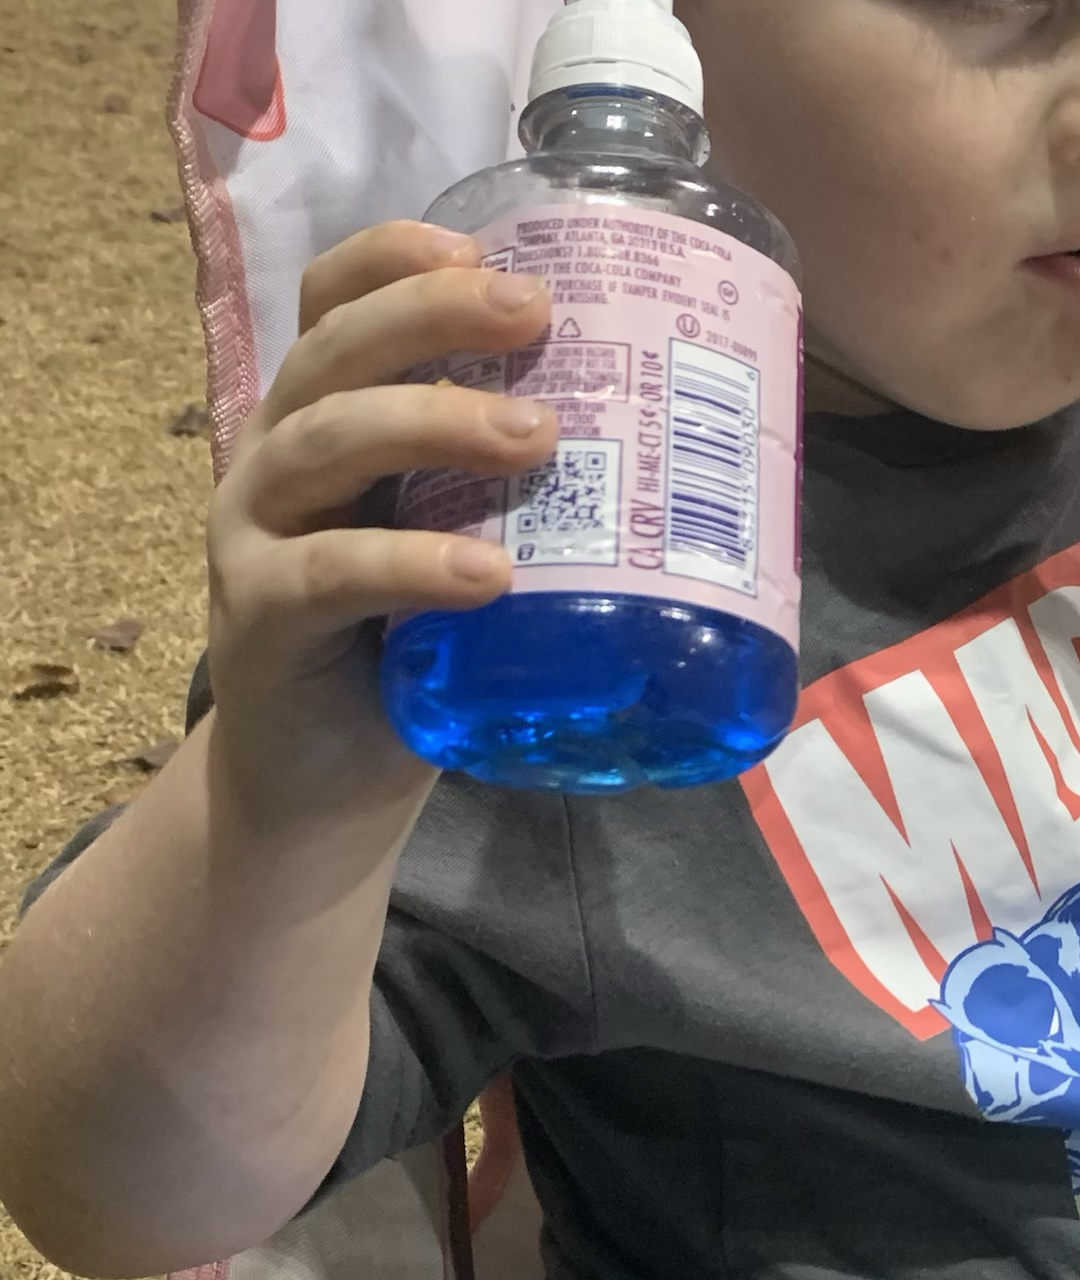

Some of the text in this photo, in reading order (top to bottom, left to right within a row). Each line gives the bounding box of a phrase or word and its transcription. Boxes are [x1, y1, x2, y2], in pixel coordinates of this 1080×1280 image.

[567, 218, 599, 230] UNDER
[602, 218, 655, 237] AUTHORITY
[657, 227, 669, 239] OF
[671, 230, 688, 245] THE
[611, 232, 625, 245] GA
[553, 262, 572, 274] THE
[575, 262, 632, 277] COCA-COLA
[634, 266, 682, 288] COMPANY
[554, 279, 603, 291] PURCHASE
[608, 280, 617, 293] IF
[622, 281, 658, 299] TAMPER
[662, 289, 697, 309] EVIDENT
[700, 300, 719, 317] SEAL
[639, 381, 663, 402] OR
[567, 413, 596, 424] FOOD
[636, 431, 662, 493] HI-ME-CT
[629, 498, 665, 539] CRV
[628, 547, 664, 570] CA
